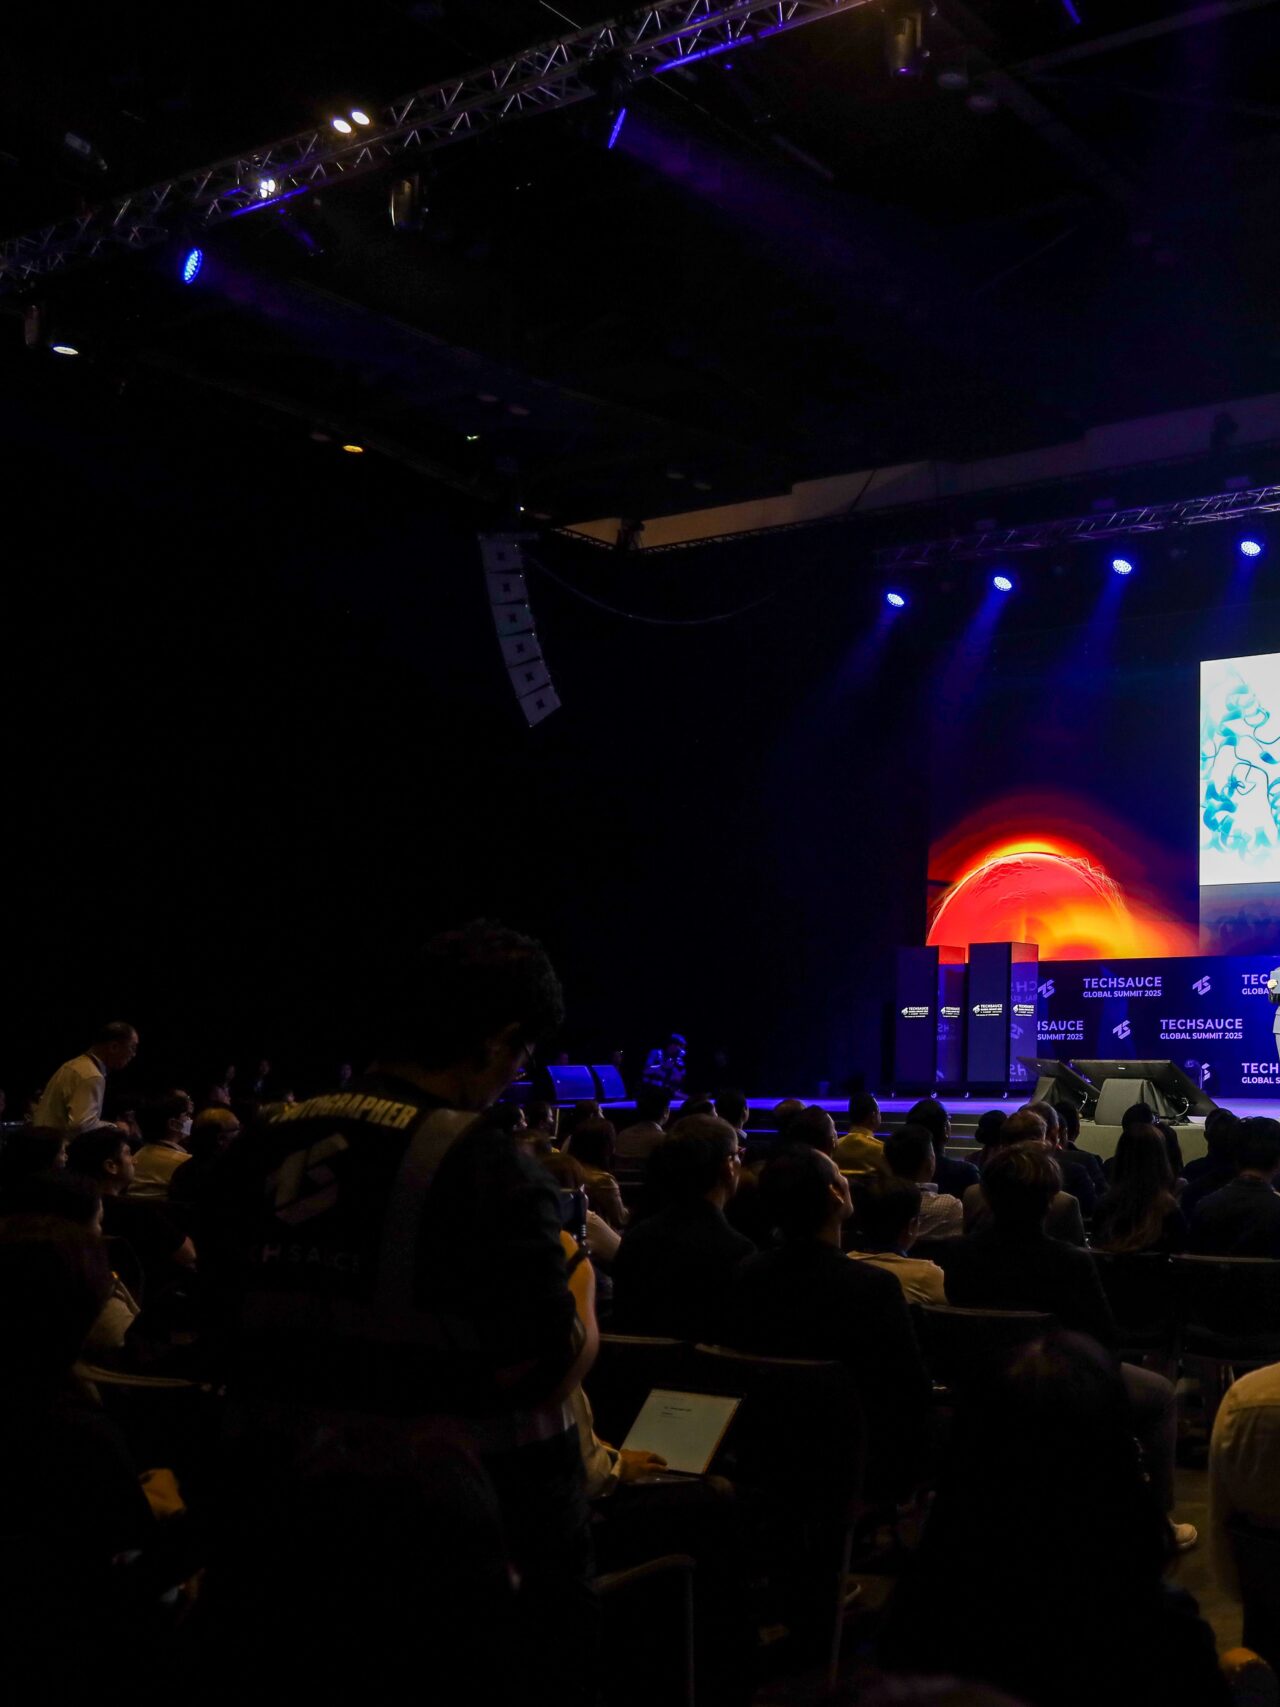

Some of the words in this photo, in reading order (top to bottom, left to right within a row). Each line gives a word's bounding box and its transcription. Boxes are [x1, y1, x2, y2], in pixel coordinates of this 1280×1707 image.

[1083, 976, 1162, 989] TECHSAUCE
[1083, 990, 1112, 998] GLOBAL
[1113, 990, 1143, 998] SUMMIT
[1145, 990, 1162, 998] 2025
[1242, 987, 1270, 995] GLOBA
[1160, 1018, 1243, 1030] TECHSAUCE
[1160, 1032, 1190, 1040] GLOBAL
[1192, 1032, 1223, 1040] SUMMIT
[1225, 1032, 1243, 1040] 2025
